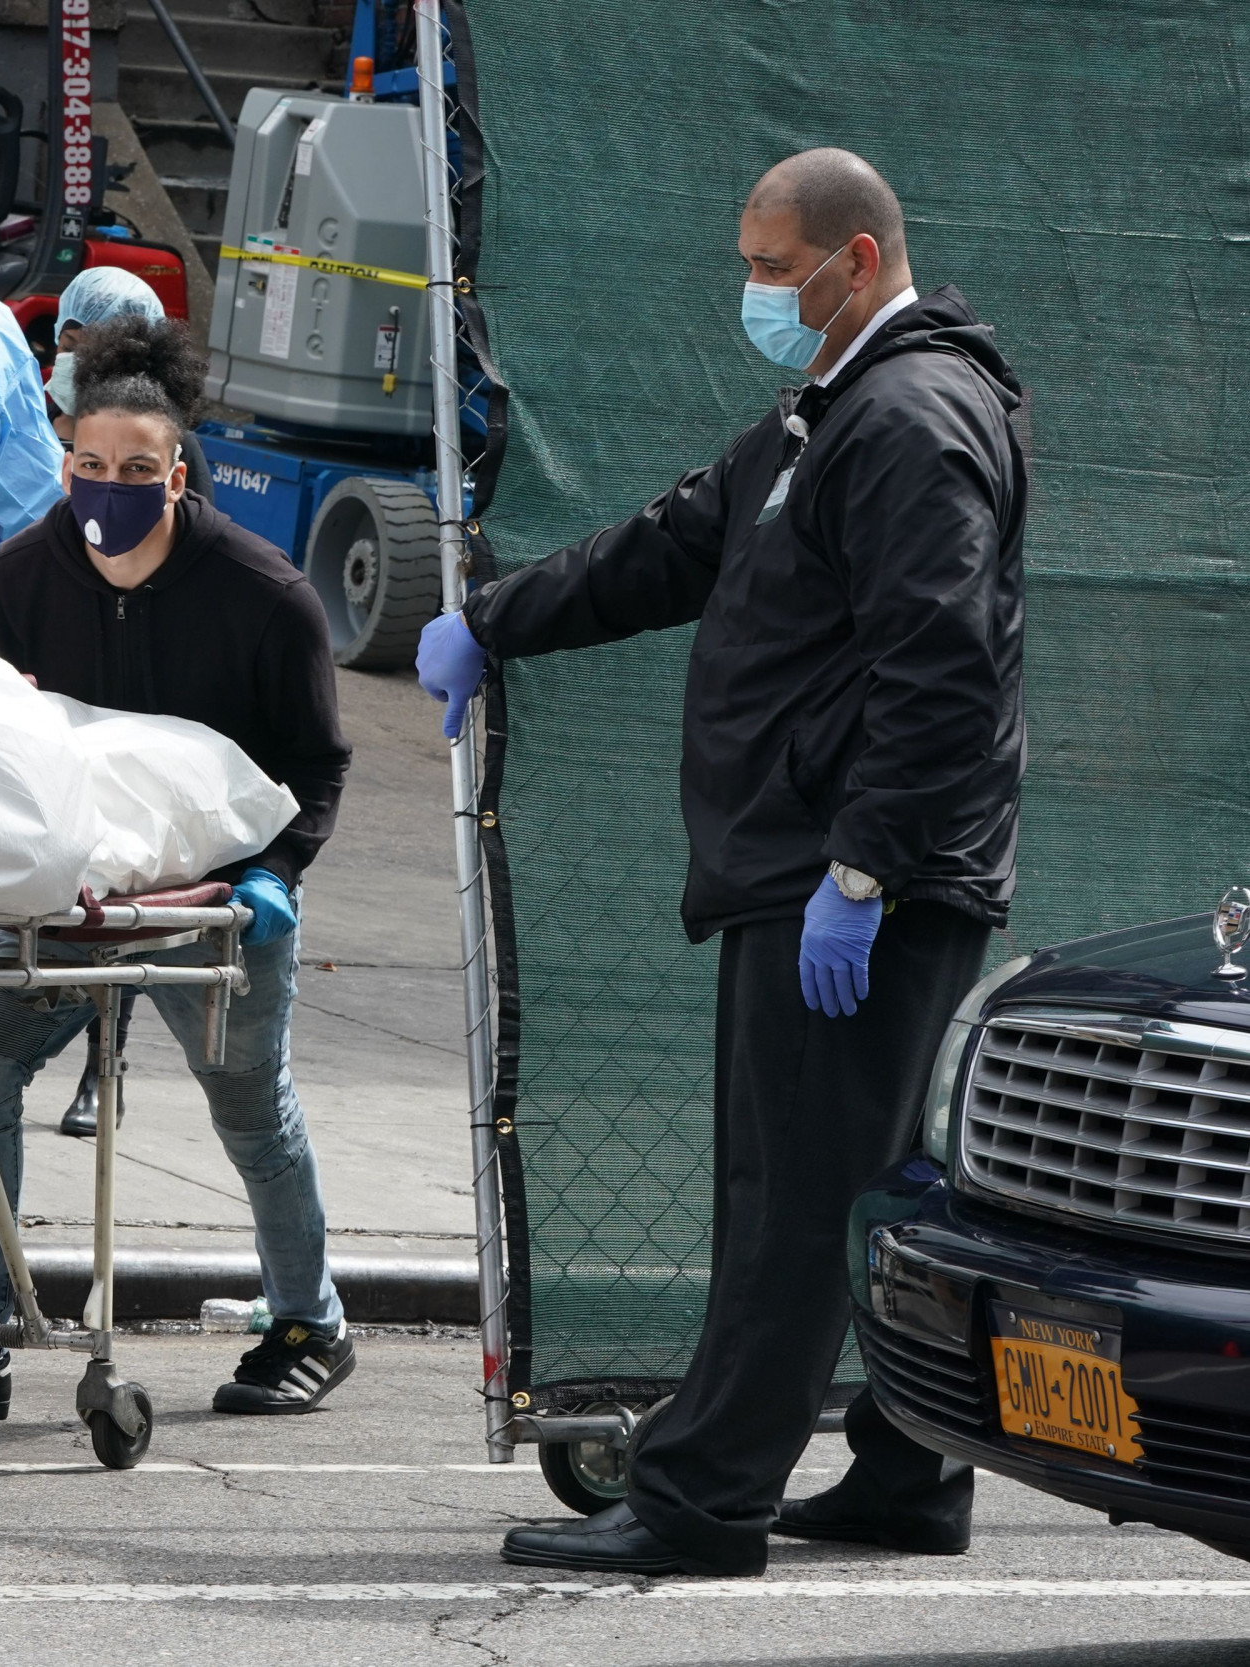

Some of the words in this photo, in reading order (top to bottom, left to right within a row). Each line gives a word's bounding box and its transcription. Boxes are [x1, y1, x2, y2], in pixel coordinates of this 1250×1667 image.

[63, 0, 91, 204] 917-304-3888
[212, 462, 272, 495] 391647
[1020, 1318, 1054, 1342] NEW
[1057, 1326, 1096, 1353] YORK
[1004, 1347, 1050, 1418] GMU
[1062, 1359, 1122, 1437] 2001
[1034, 1419, 1075, 1444] EMPIRE
[1076, 1432, 1109, 1453] STATE
